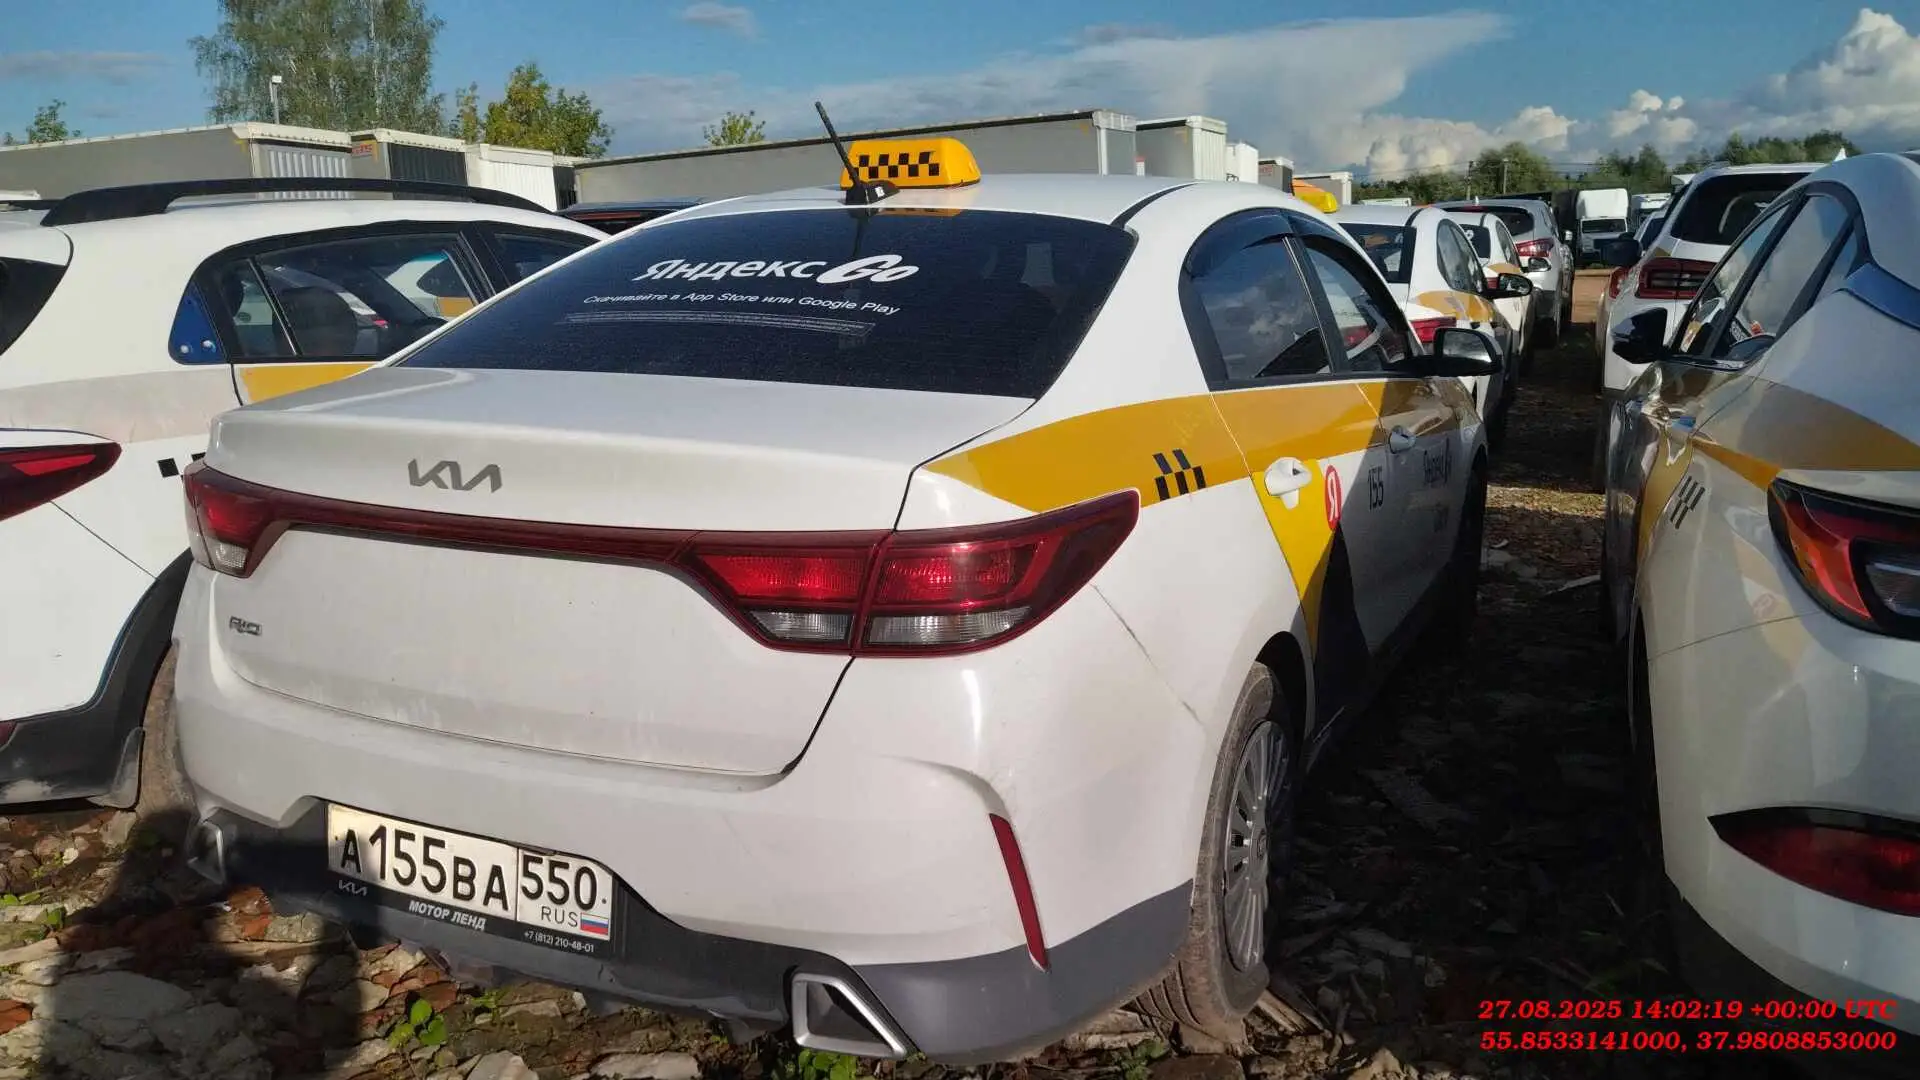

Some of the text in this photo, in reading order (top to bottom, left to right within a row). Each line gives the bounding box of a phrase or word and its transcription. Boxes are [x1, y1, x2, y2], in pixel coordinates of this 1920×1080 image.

[632, 259, 827, 281] Яндекс
[682, 292, 715, 302] App
[717, 293, 760, 302] Store
[761, 296, 795, 304] или
[798, 297, 858, 309] Google
[860, 302, 900, 315] Play
[1367, 466, 1384, 511] 155
[521, 854, 597, 910] 550
[408, 900, 487, 931] МОТОР ЛЕНД
[541, 905, 578, 927] RUS
[524, 930, 595, 953] +7 (812) 210-48-01
